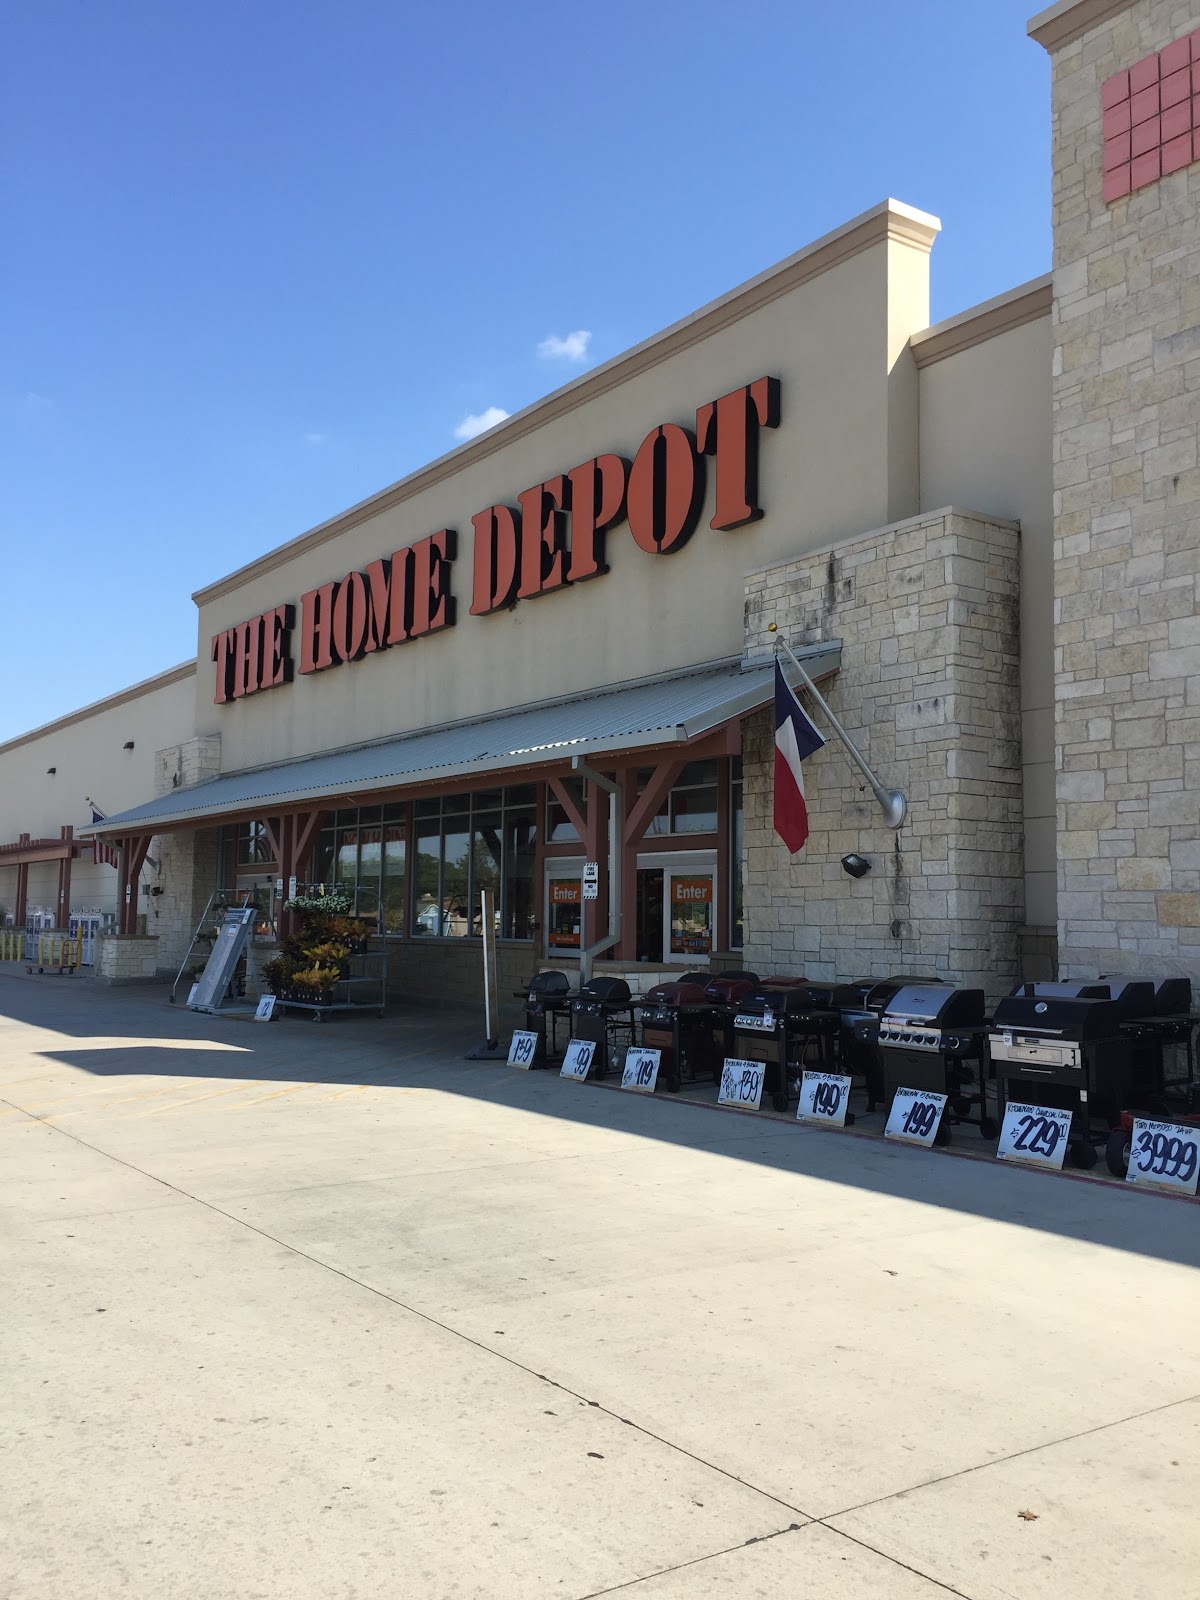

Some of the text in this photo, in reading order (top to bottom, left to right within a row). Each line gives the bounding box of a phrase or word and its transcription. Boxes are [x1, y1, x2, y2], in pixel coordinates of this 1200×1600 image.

[211, 376, 780, 704] THE HOME DEPOT
[553, 886, 577, 900] Enter
[676, 884, 708, 899] Enter
